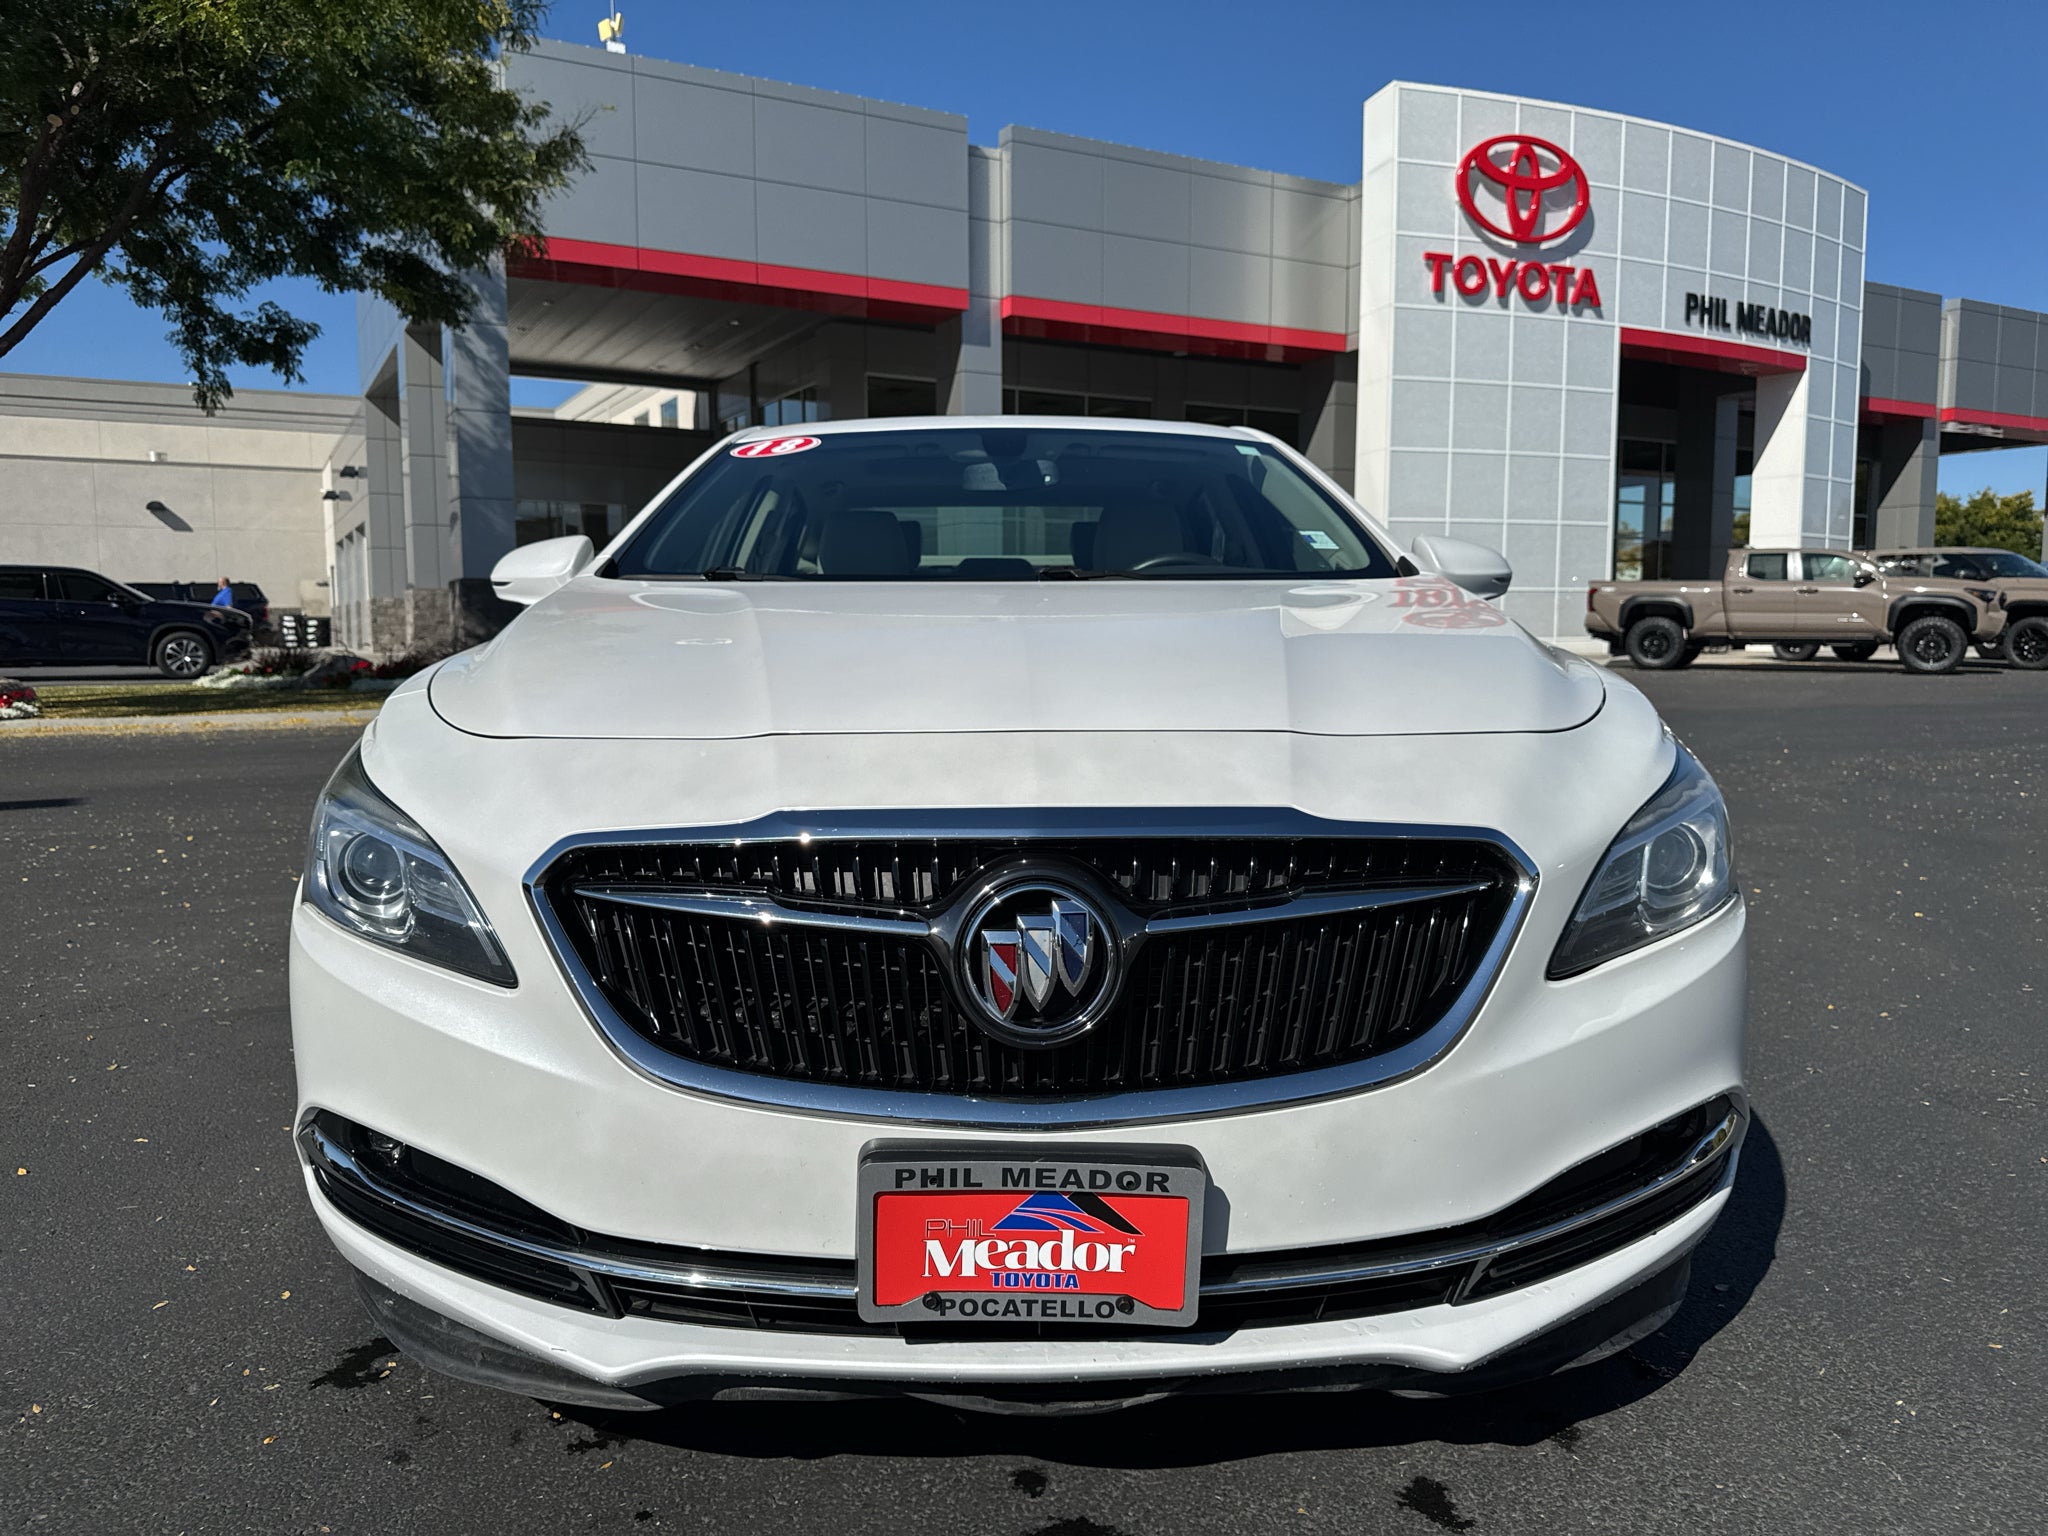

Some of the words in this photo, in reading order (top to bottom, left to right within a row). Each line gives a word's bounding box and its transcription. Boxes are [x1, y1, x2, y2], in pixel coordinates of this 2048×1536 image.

[1423, 252, 1602, 307] TOYOTA
[1685, 292, 1731, 332] PHIL
[1736, 301, 1811, 345] MEADOR
[746, 437, 806, 456] 18
[895, 1168, 983, 1189] PHIL
[1001, 1167, 1170, 1193] MEADOR
[924, 1218, 996, 1238] PHIL
[921, 1228, 1136, 1278] Meador
[990, 1271, 1080, 1289] TOYOTA
[938, 1298, 1116, 1319] POCATELLO
